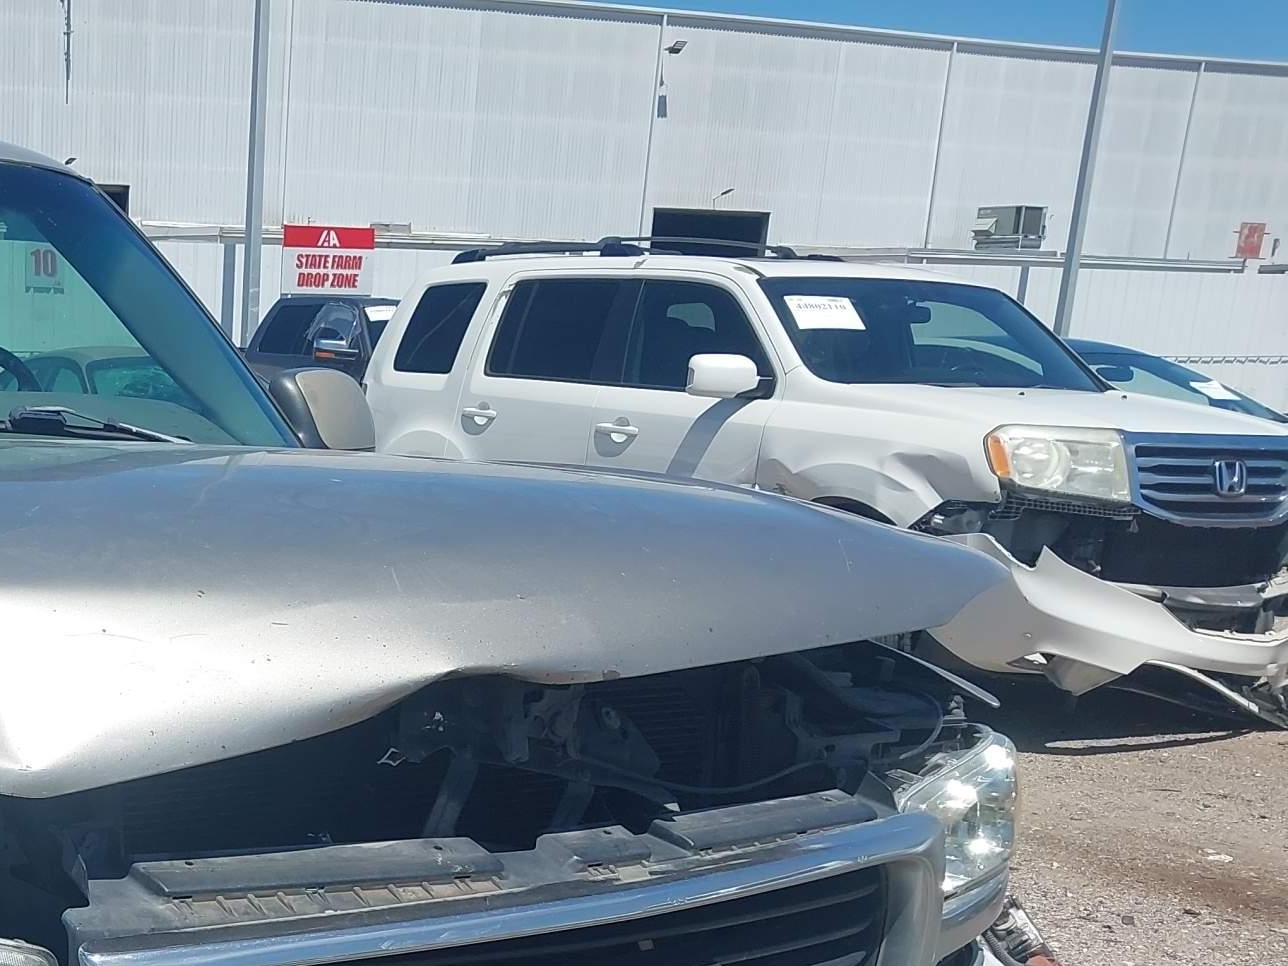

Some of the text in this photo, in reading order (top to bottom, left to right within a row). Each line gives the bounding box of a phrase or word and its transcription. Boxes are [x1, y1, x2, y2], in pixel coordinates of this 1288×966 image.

[30, 248, 57, 278] 10
[295, 253, 362, 270] STATE FARM
[297, 272, 359, 288] DROP ZONE
